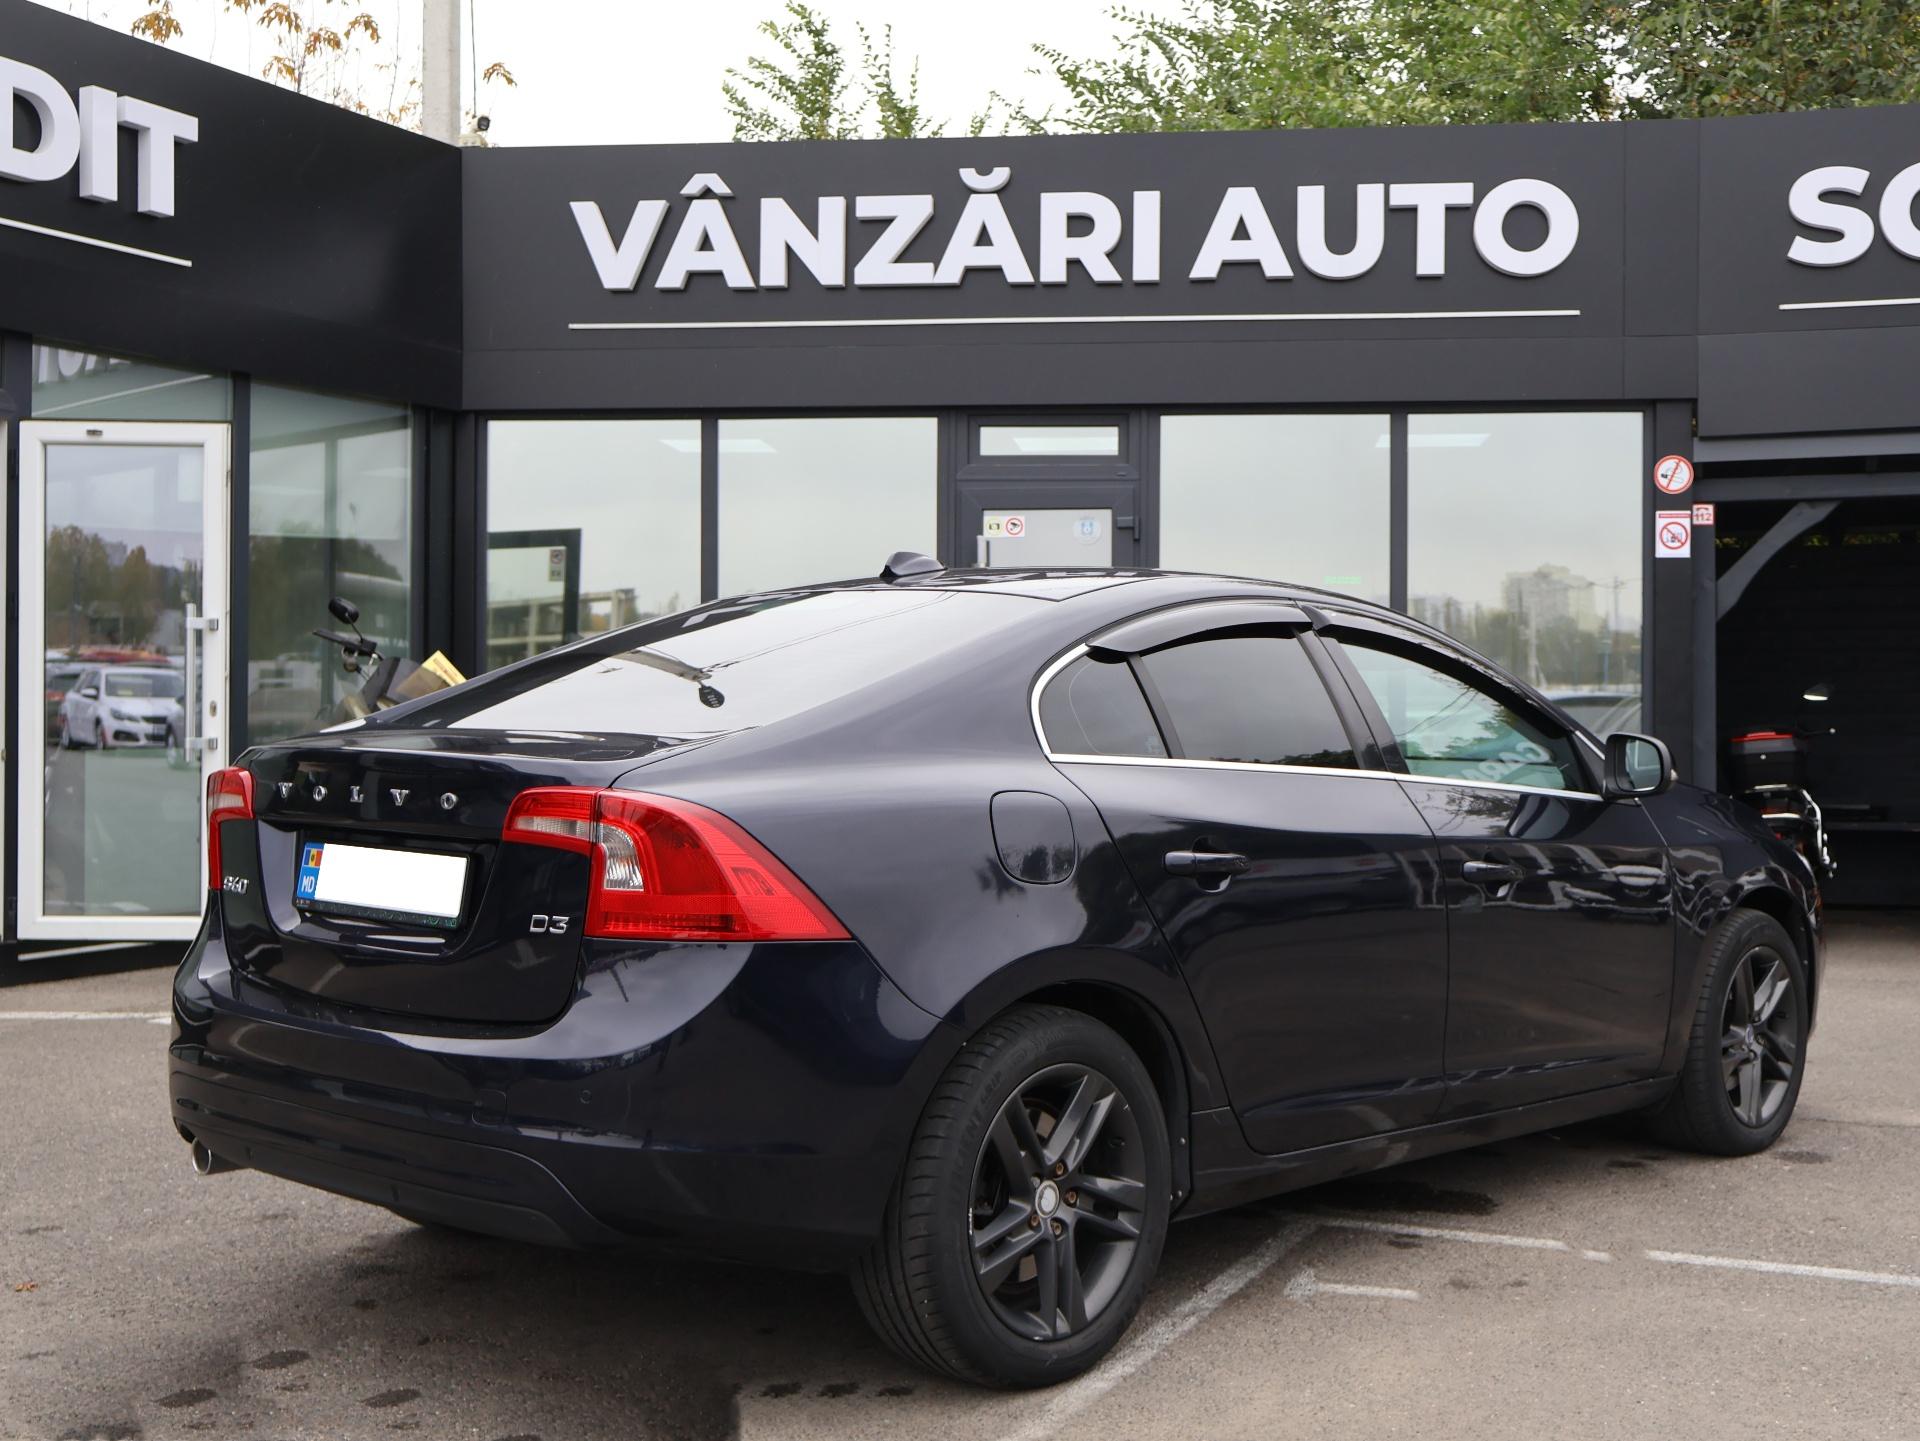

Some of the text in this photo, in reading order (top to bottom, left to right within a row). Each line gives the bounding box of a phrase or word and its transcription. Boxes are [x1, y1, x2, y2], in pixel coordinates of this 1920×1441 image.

[0, 56, 199, 218] DIT
[569, 167, 1580, 292] VÂNZĂRI AUTO
[1695, 513, 1712, 521] 112
[278, 781, 459, 810] VOLVO
[223, 875, 249, 894] S60
[302, 875, 315, 893] MD
[529, 914, 570, 934] D3
